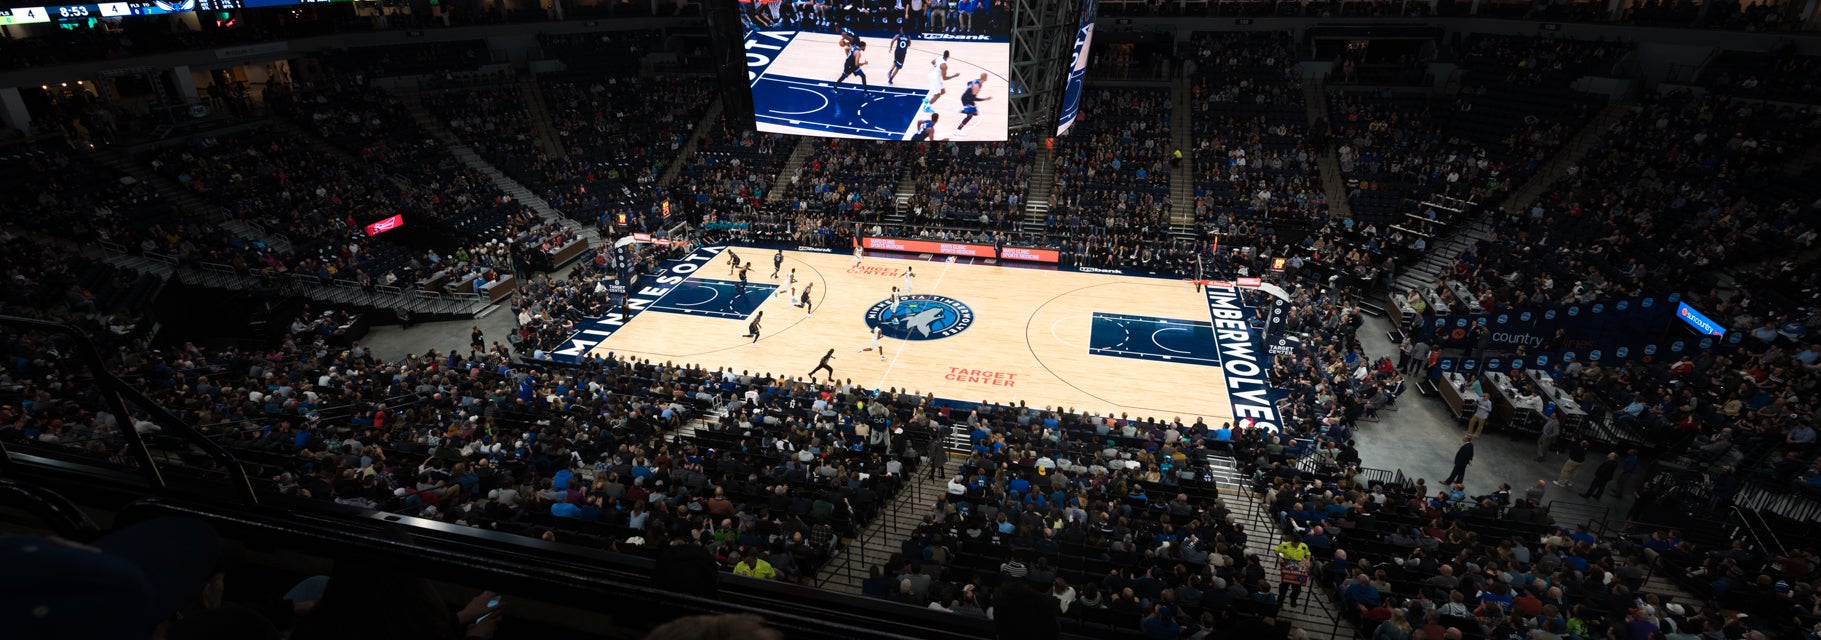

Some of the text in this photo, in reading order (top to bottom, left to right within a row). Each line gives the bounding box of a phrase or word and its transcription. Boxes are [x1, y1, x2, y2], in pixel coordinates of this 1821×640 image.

[28, 9, 35, 18] 4
[58, 5, 89, 17] 8:53
[111, 4, 118, 14] 4
[744, 30, 796, 80] OTA
[554, 245, 727, 356] MINNESOTA
[868, 296, 970, 336] MINNEOTA TIMBERWOLVES
[1492, 332, 1544, 349] country
[948, 366, 1018, 380] TARGET
[944, 374, 1016, 388] CENTER
